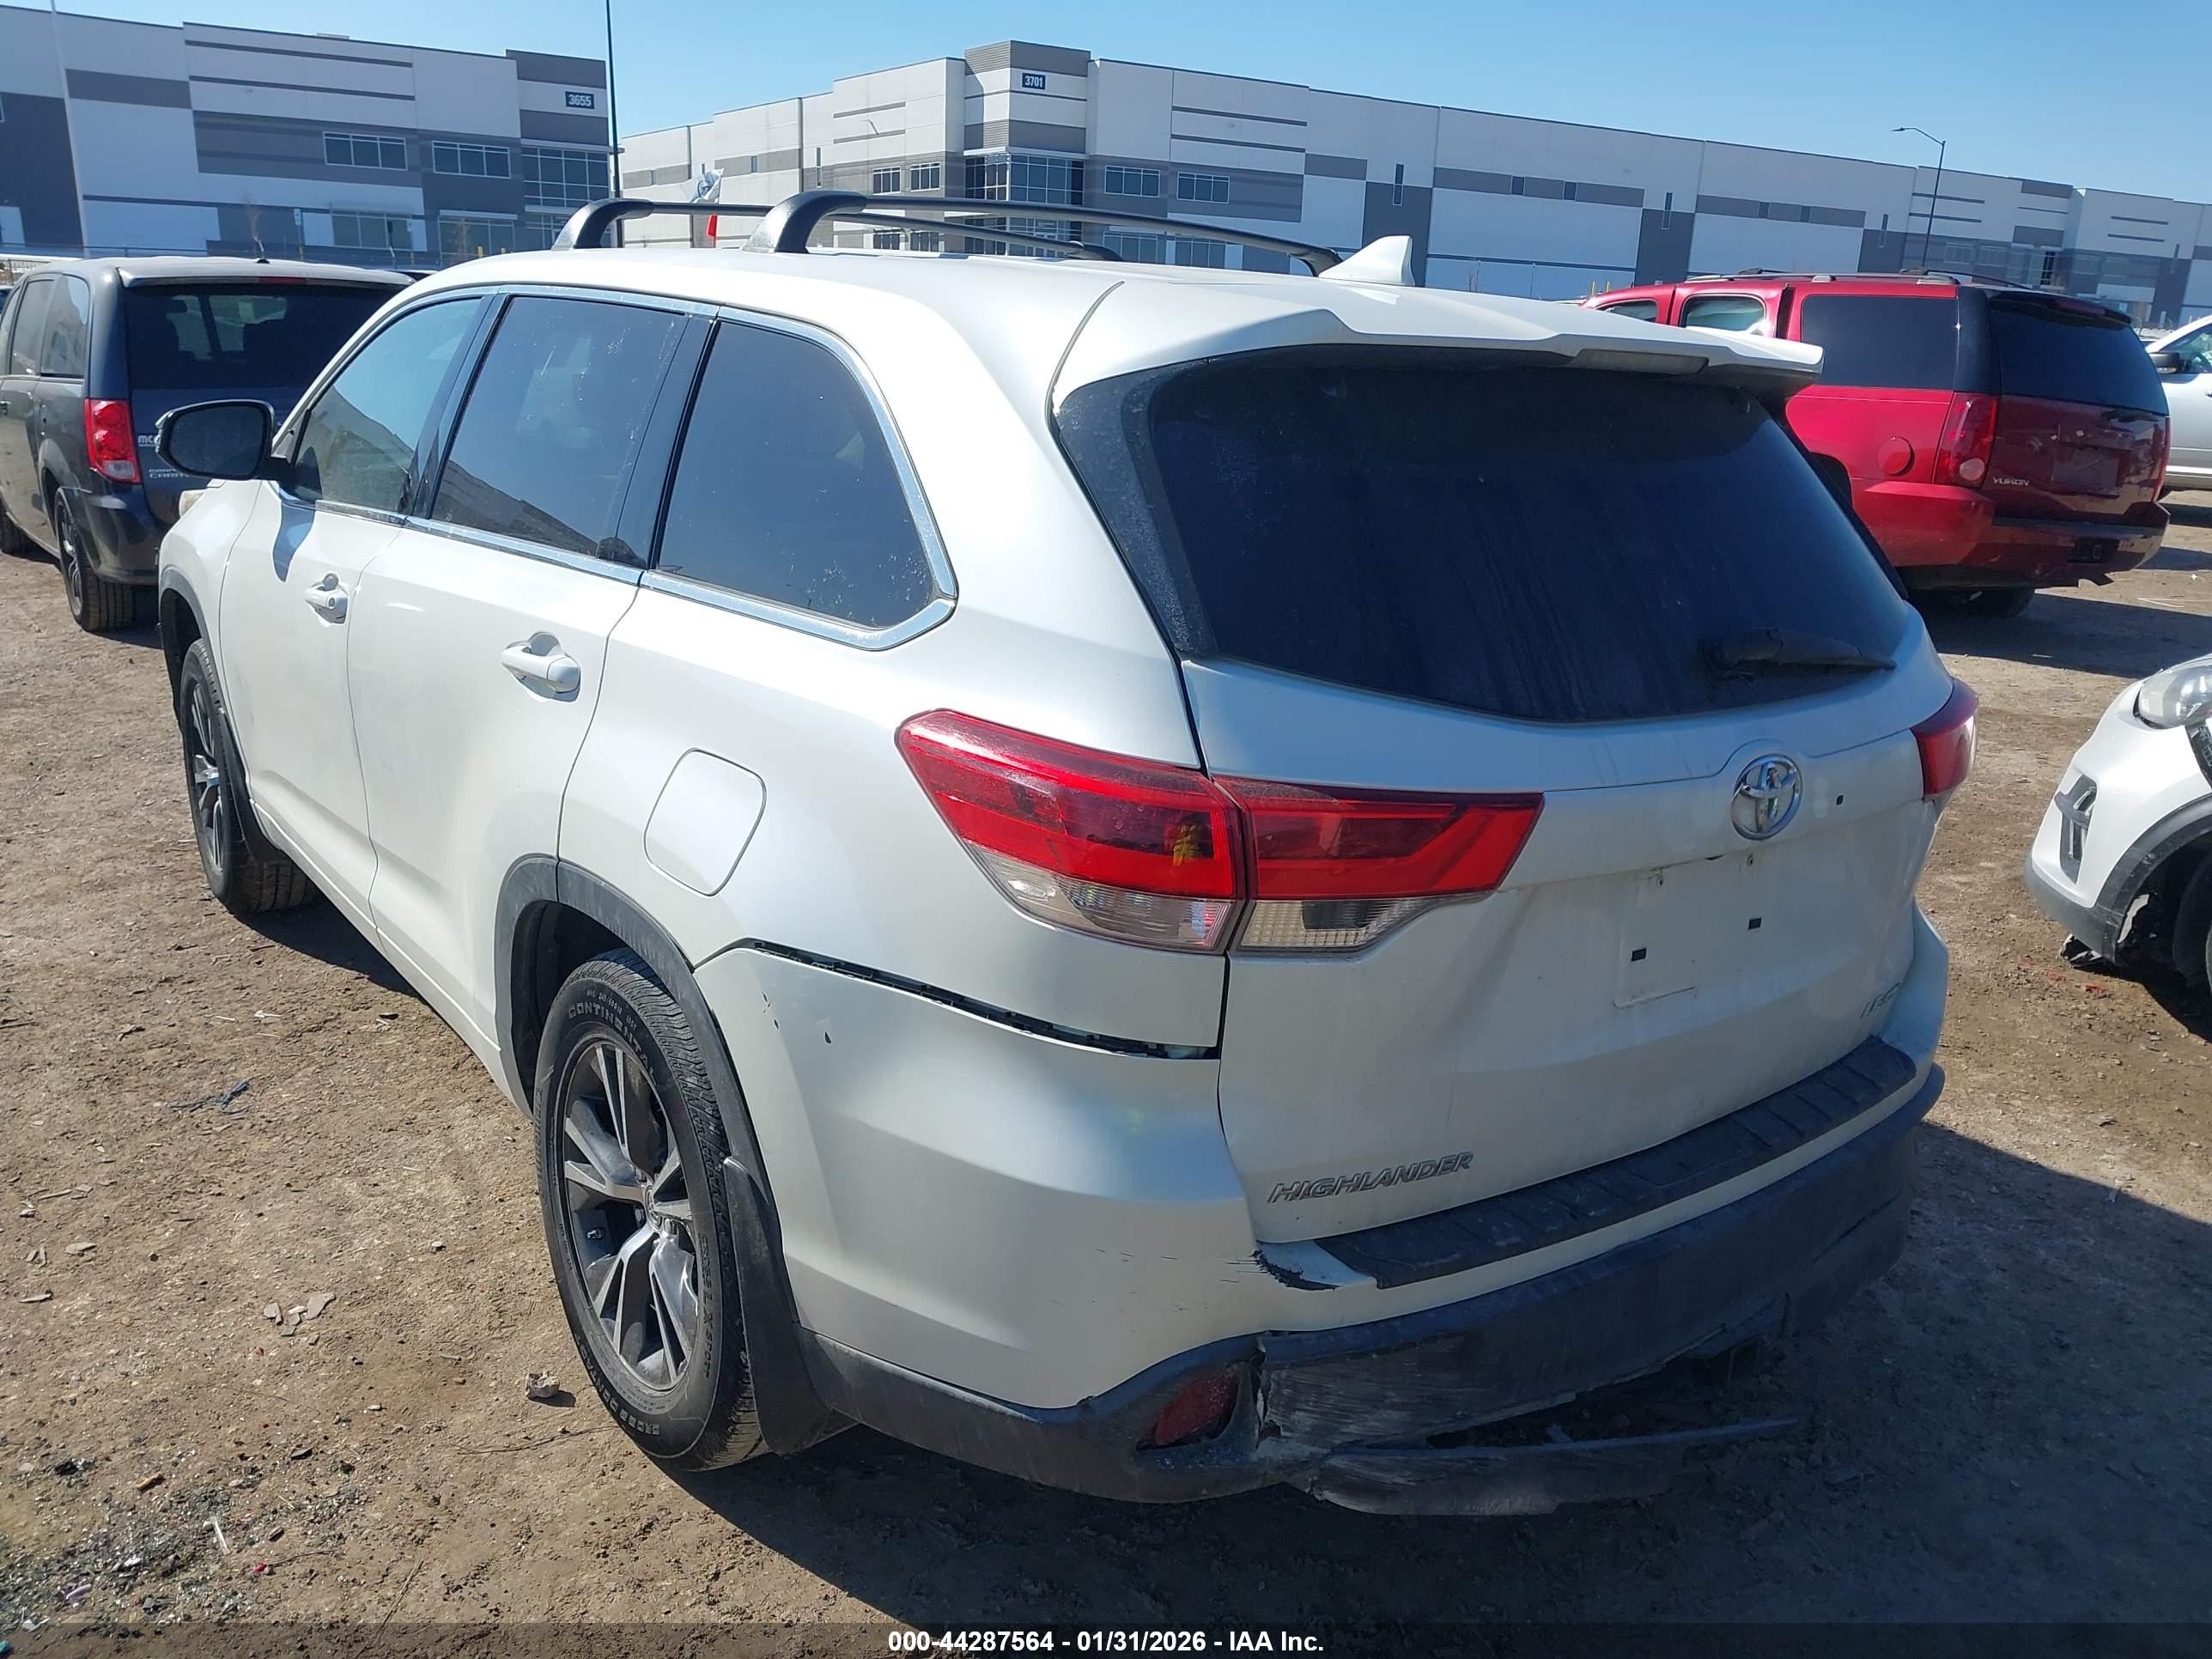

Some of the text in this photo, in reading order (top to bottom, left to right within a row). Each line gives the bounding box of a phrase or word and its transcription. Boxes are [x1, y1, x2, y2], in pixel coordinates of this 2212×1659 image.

[1024, 75, 1043, 88] 3701
[568, 94, 592, 106] 3655
[1993, 477, 2030, 487] YUKON
[568, 1000, 657, 1086] CONTINENTAL
[1267, 1151, 1474, 1203] HIGHLANDER
